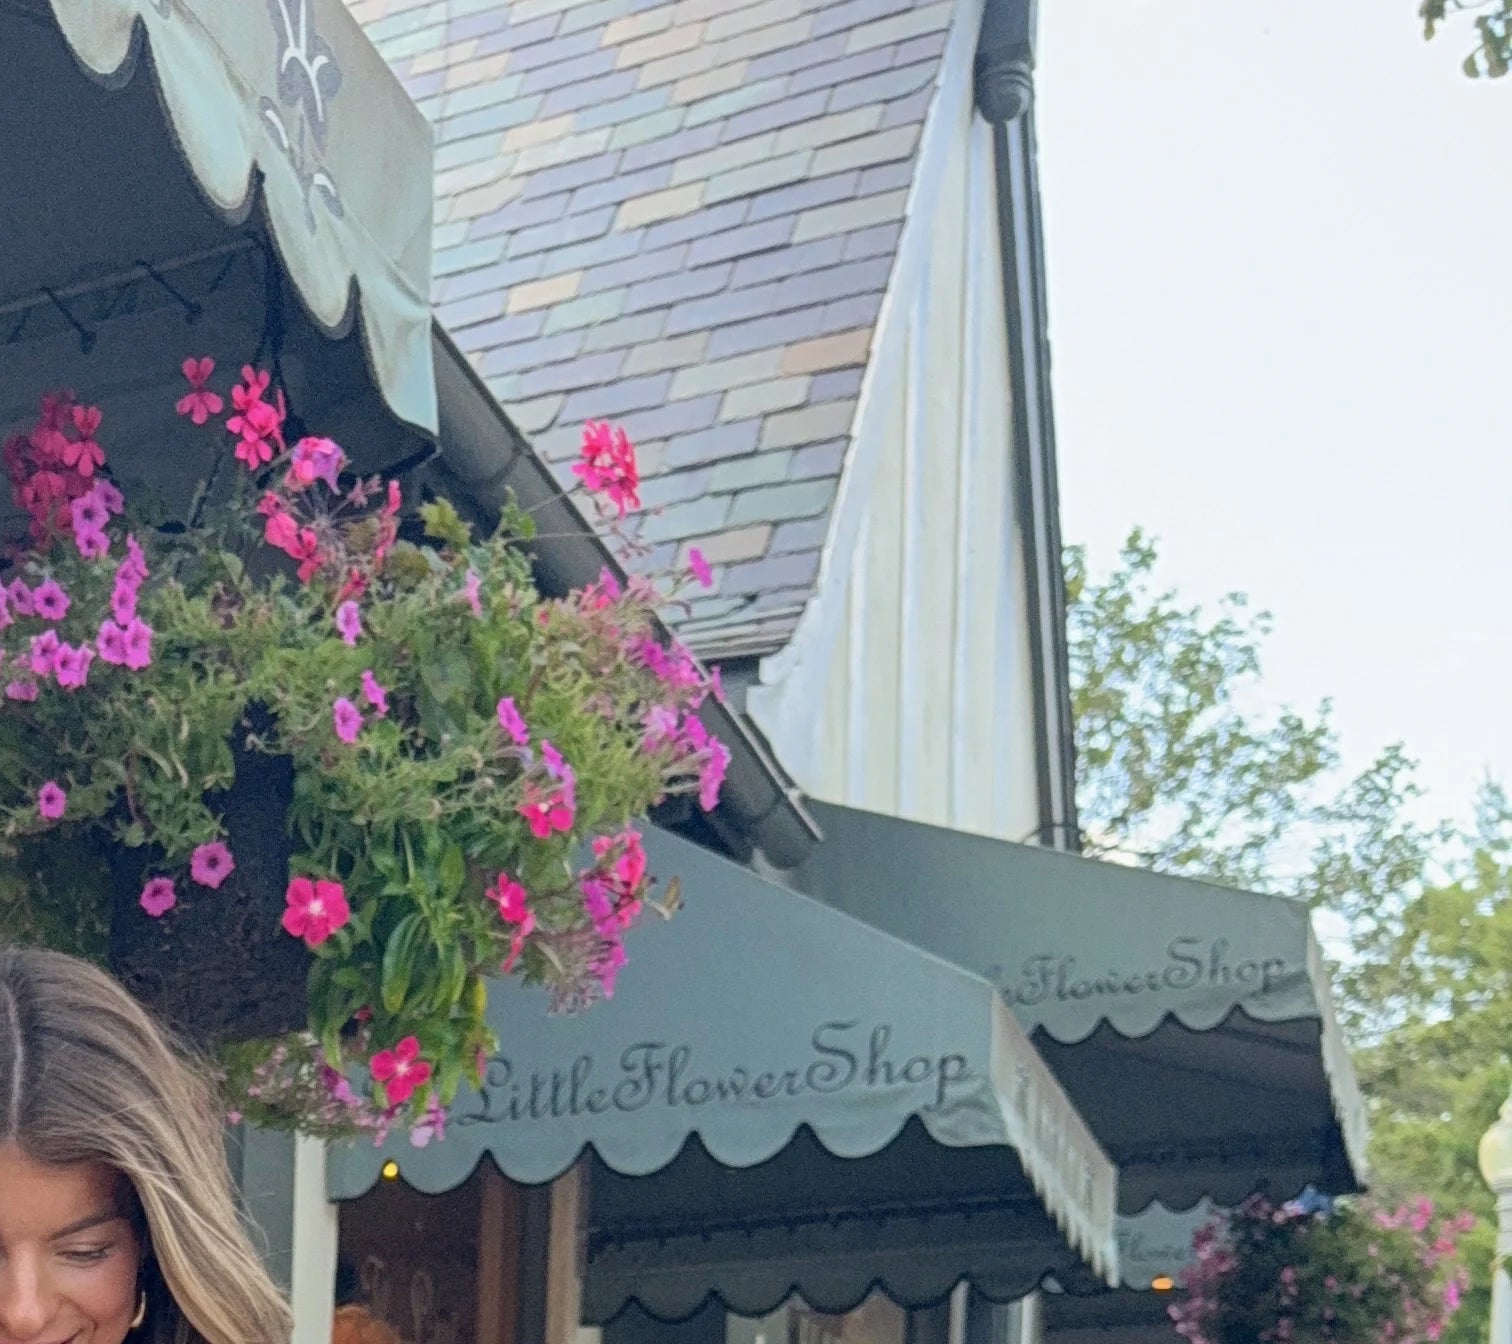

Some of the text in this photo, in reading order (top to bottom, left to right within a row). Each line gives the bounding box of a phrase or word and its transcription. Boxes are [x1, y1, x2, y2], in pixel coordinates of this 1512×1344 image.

[1015, 952, 1165, 1006] Flower
[1162, 935, 1289, 1001] Shop
[446, 1020, 975, 1127] Little Flower Shop
